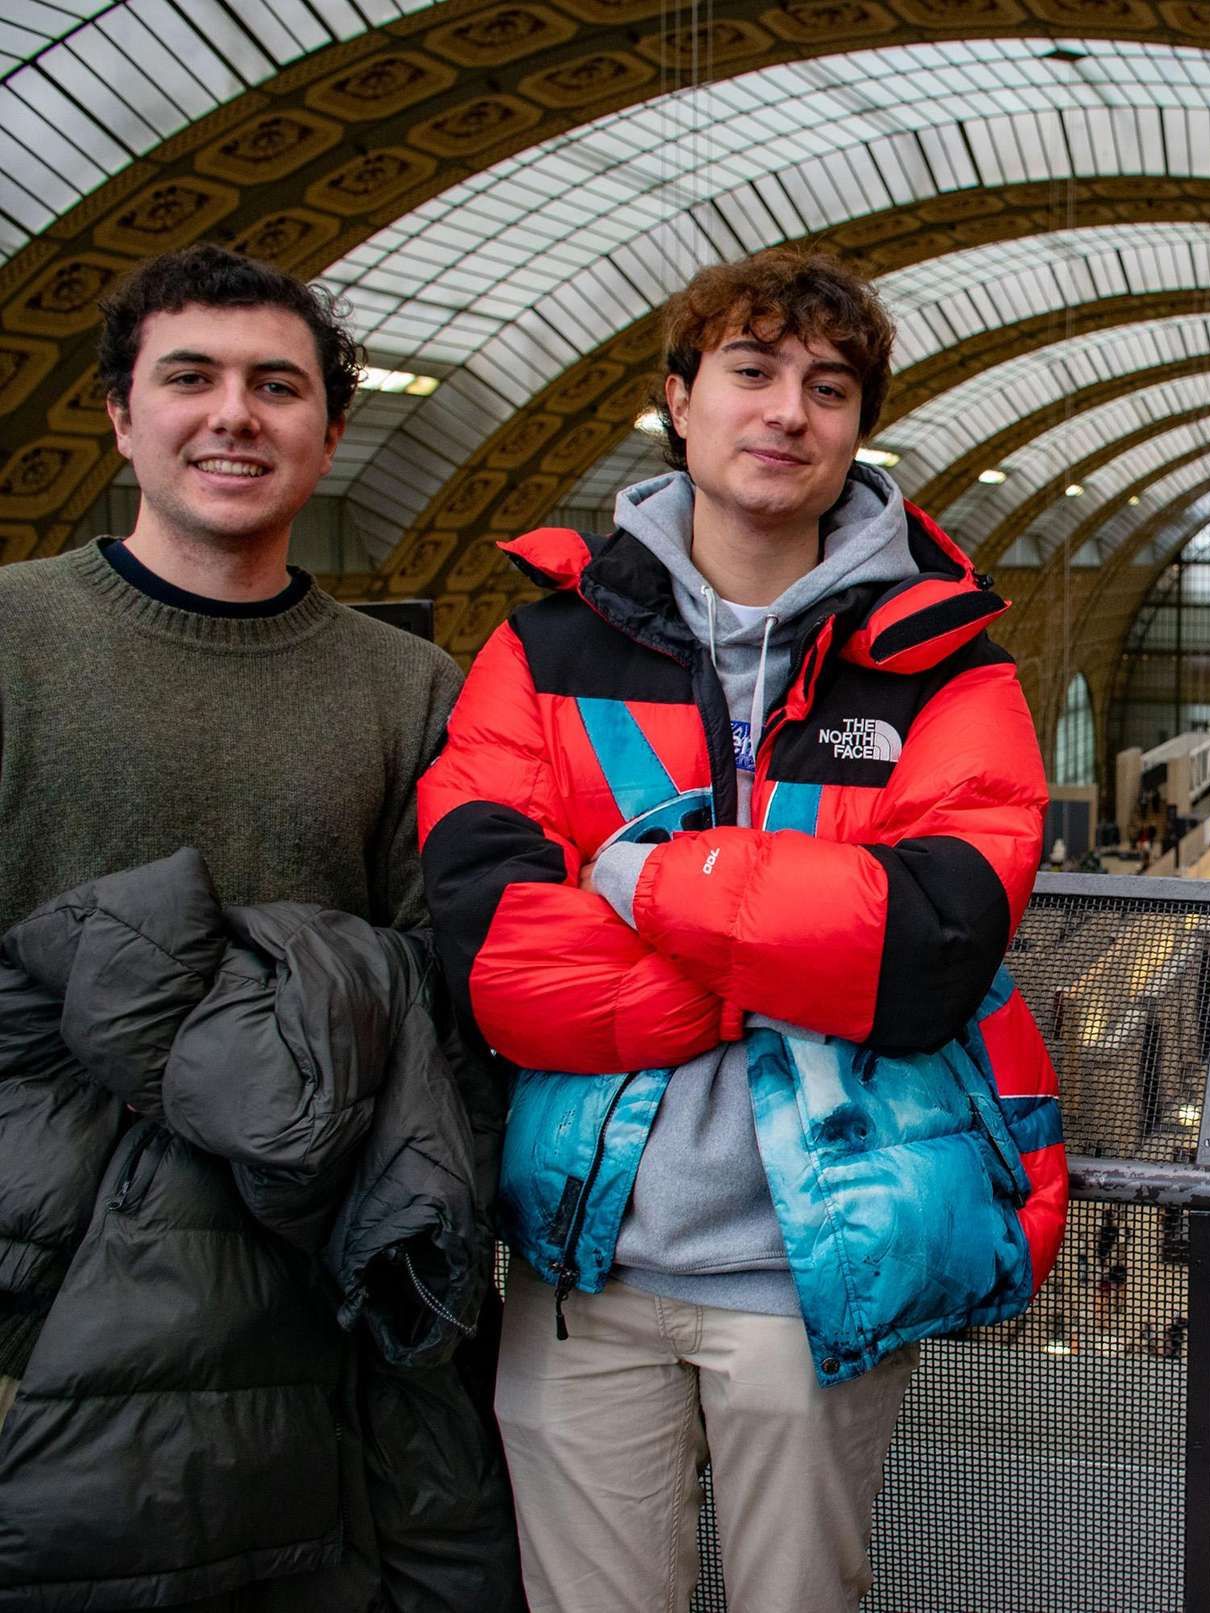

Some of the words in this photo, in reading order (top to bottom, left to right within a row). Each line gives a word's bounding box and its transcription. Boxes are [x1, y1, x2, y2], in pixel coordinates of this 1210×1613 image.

[843, 718, 875, 732] THE
[818, 729, 874, 746] NORTH
[834, 744, 874, 759] FACE
